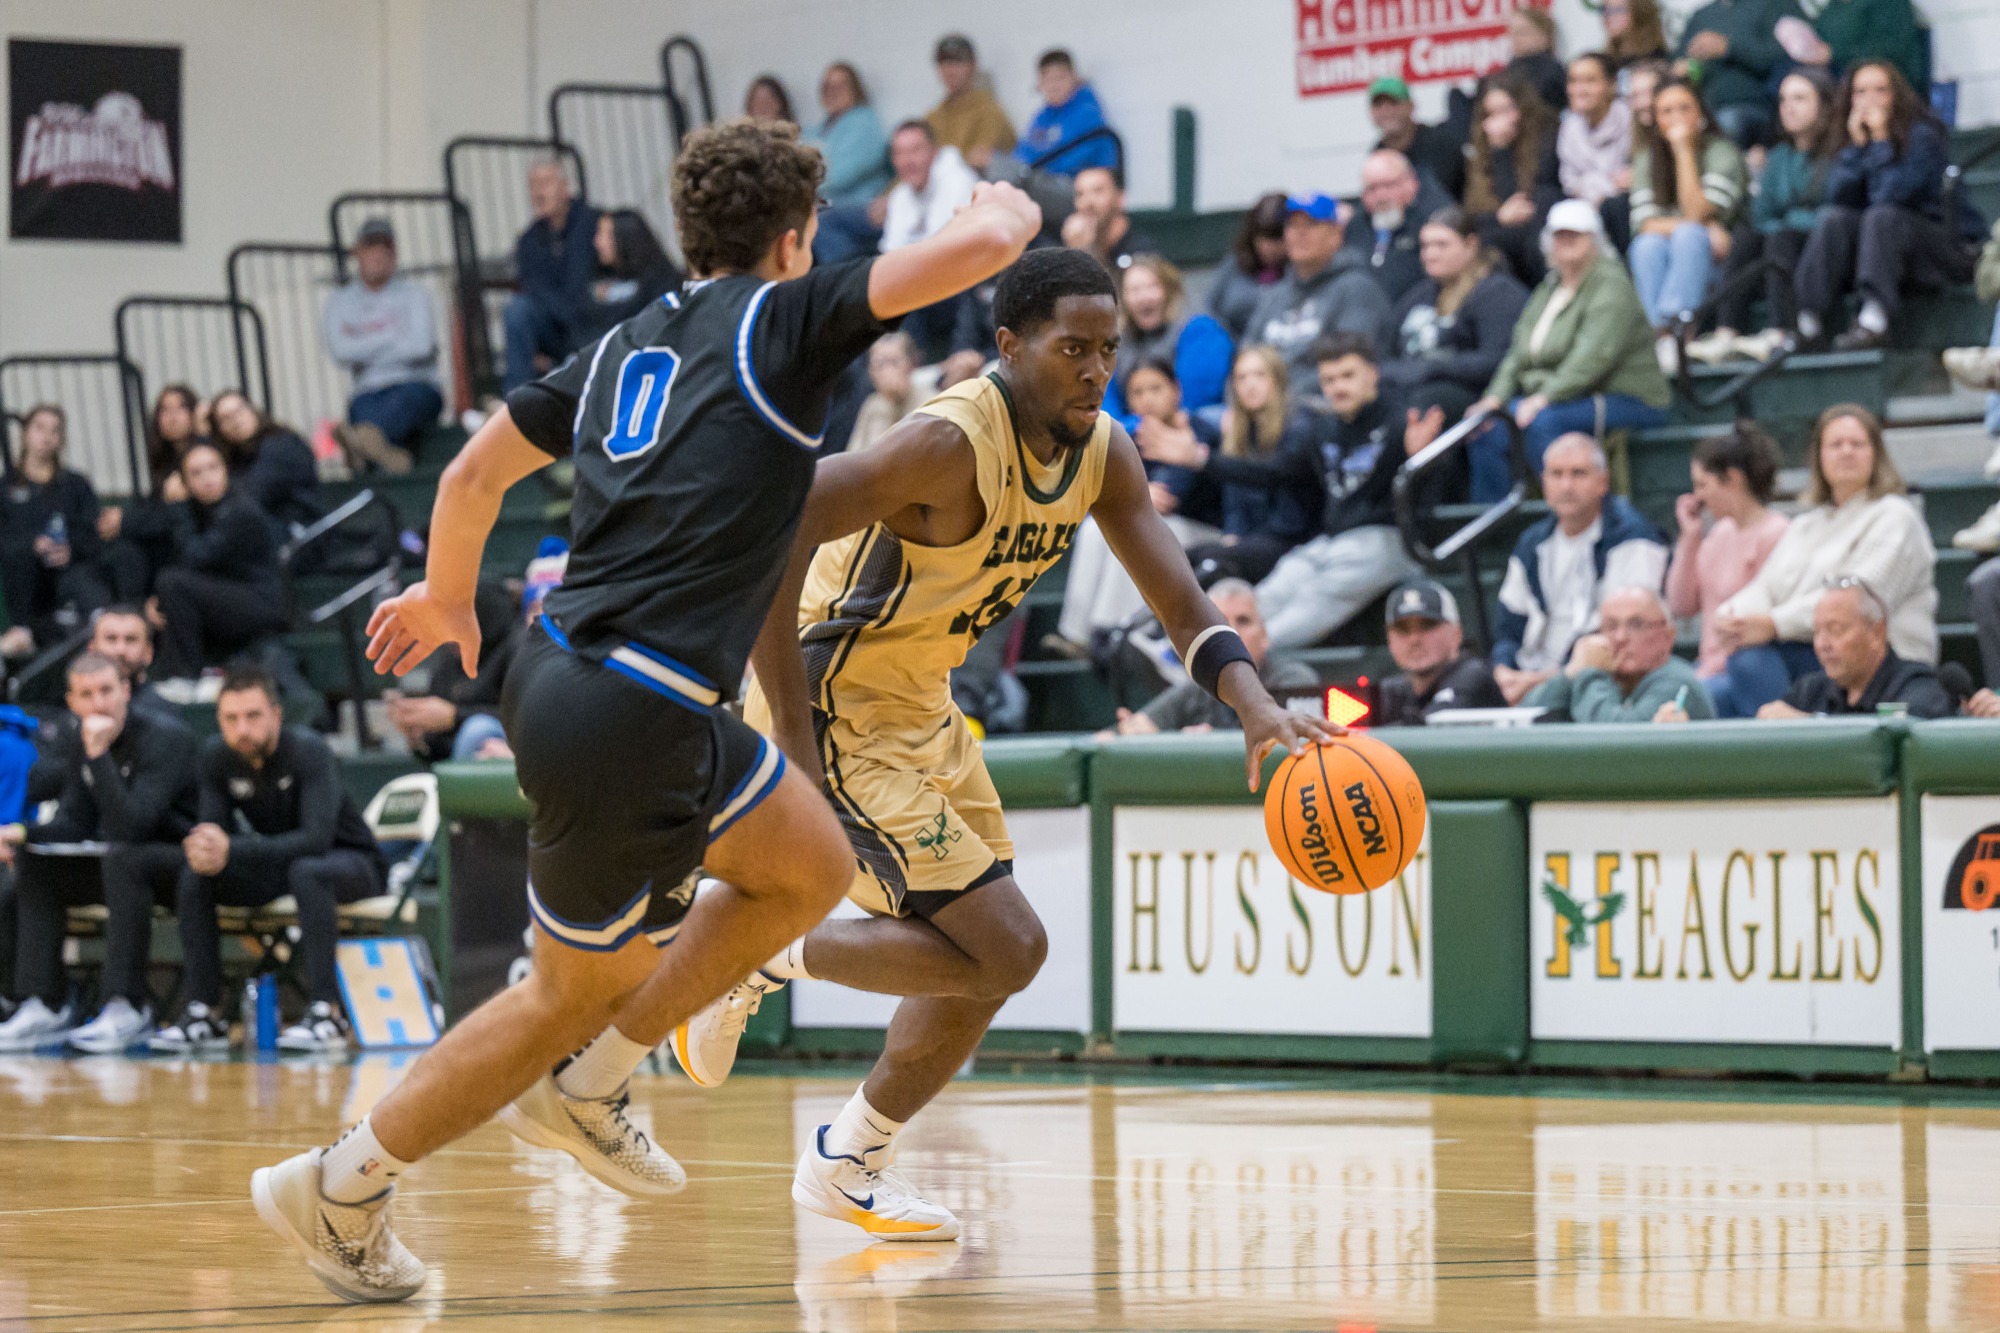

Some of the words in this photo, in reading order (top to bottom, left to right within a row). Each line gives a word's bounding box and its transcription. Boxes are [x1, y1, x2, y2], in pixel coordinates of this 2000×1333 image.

[602, 346, 681, 462] 0
[1300, 783, 1345, 885] Wilson
[1344, 781, 1387, 857] NCAA
[1127, 850, 1424, 978] HUSSON
[1631, 849, 1883, 984] EAGLES
